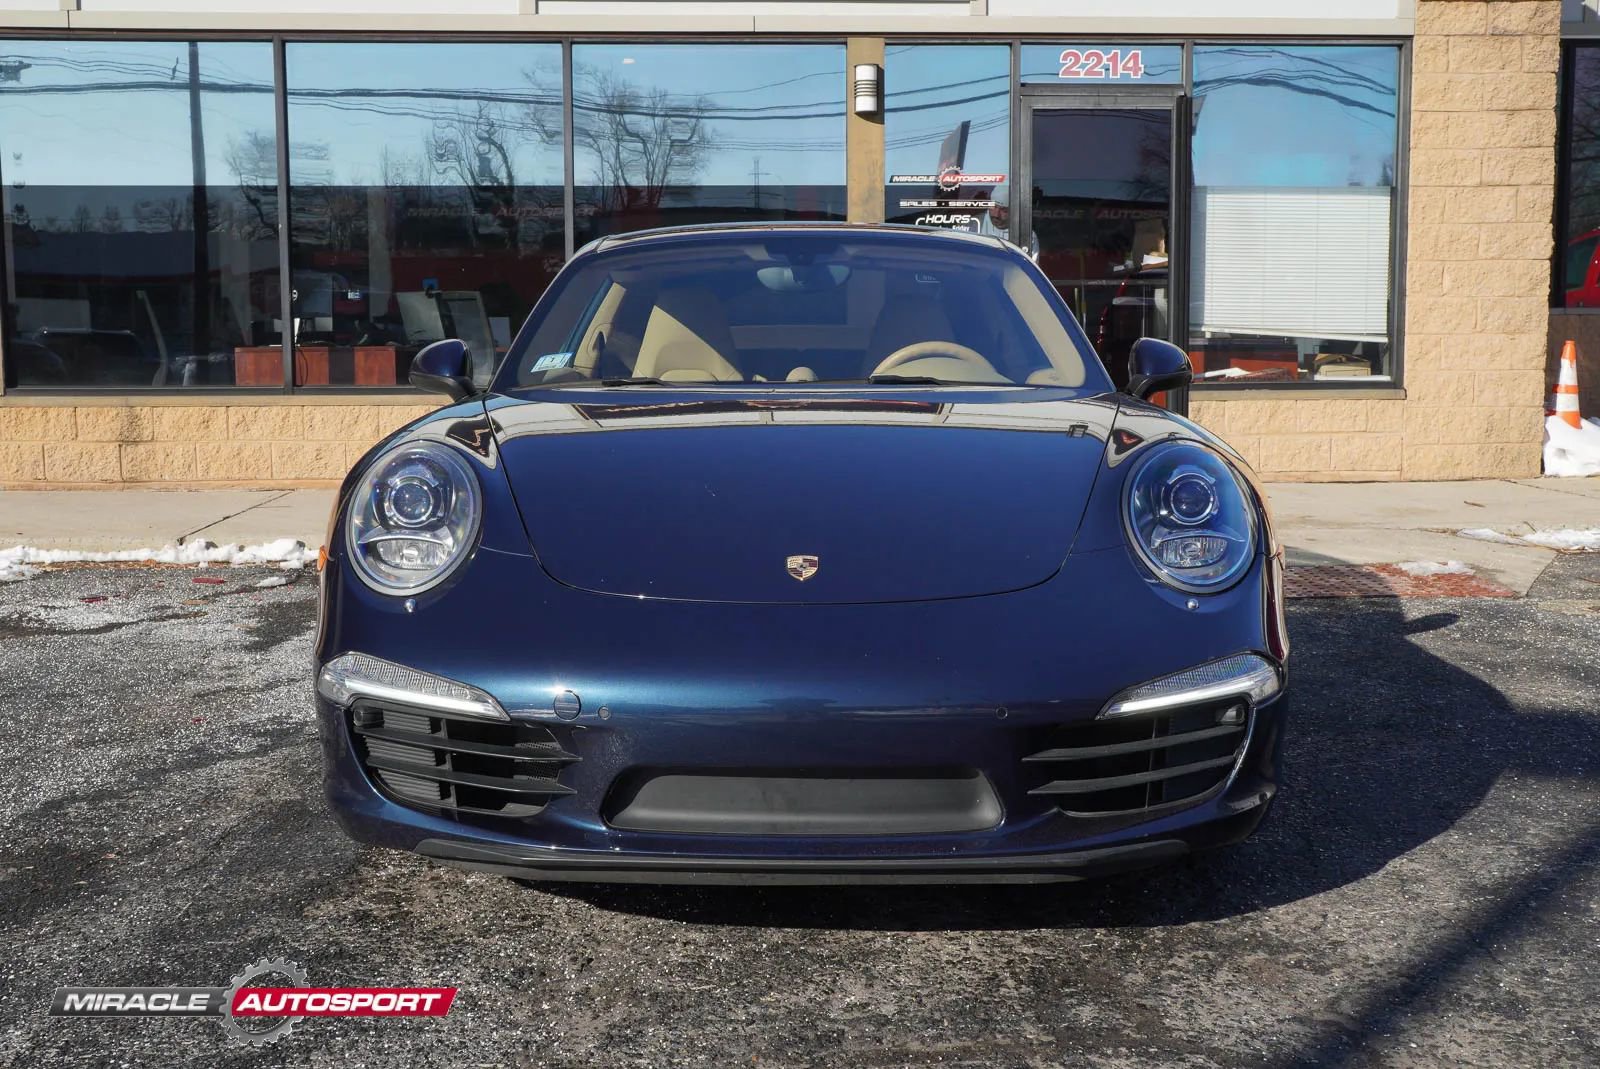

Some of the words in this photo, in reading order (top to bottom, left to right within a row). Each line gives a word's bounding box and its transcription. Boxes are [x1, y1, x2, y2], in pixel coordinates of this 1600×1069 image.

[1059, 49, 1144, 78] 2214
[496, 207, 597, 217] AUTOSPRT
[925, 214, 971, 224] HOURS
